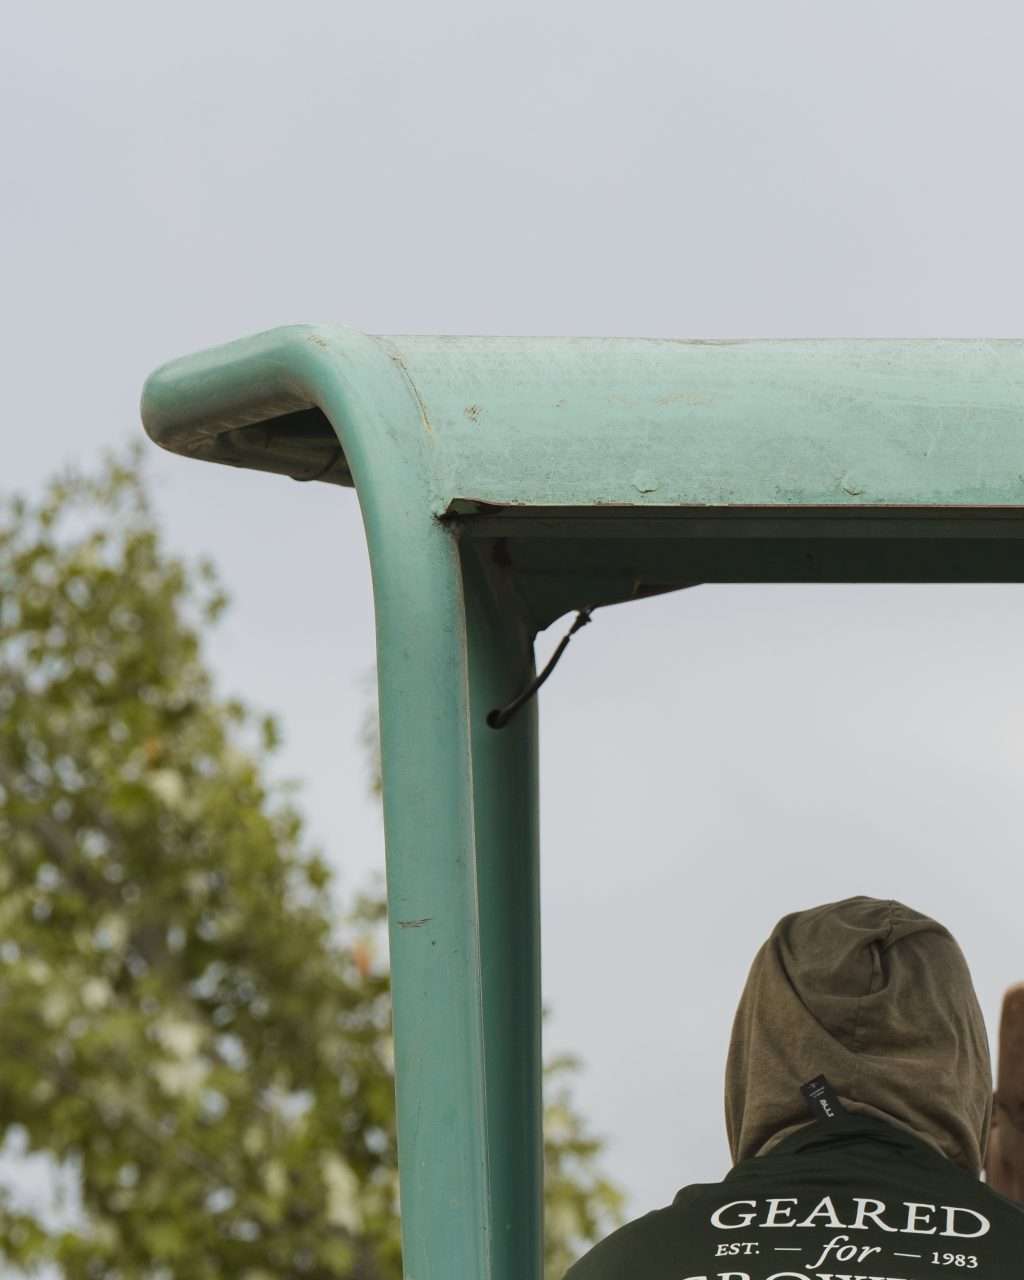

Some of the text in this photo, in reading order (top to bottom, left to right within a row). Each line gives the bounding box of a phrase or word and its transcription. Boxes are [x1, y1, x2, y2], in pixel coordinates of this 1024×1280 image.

[710, 1196, 990, 1238] GEARED
[715, 1235, 979, 1270] EST. for 1983
